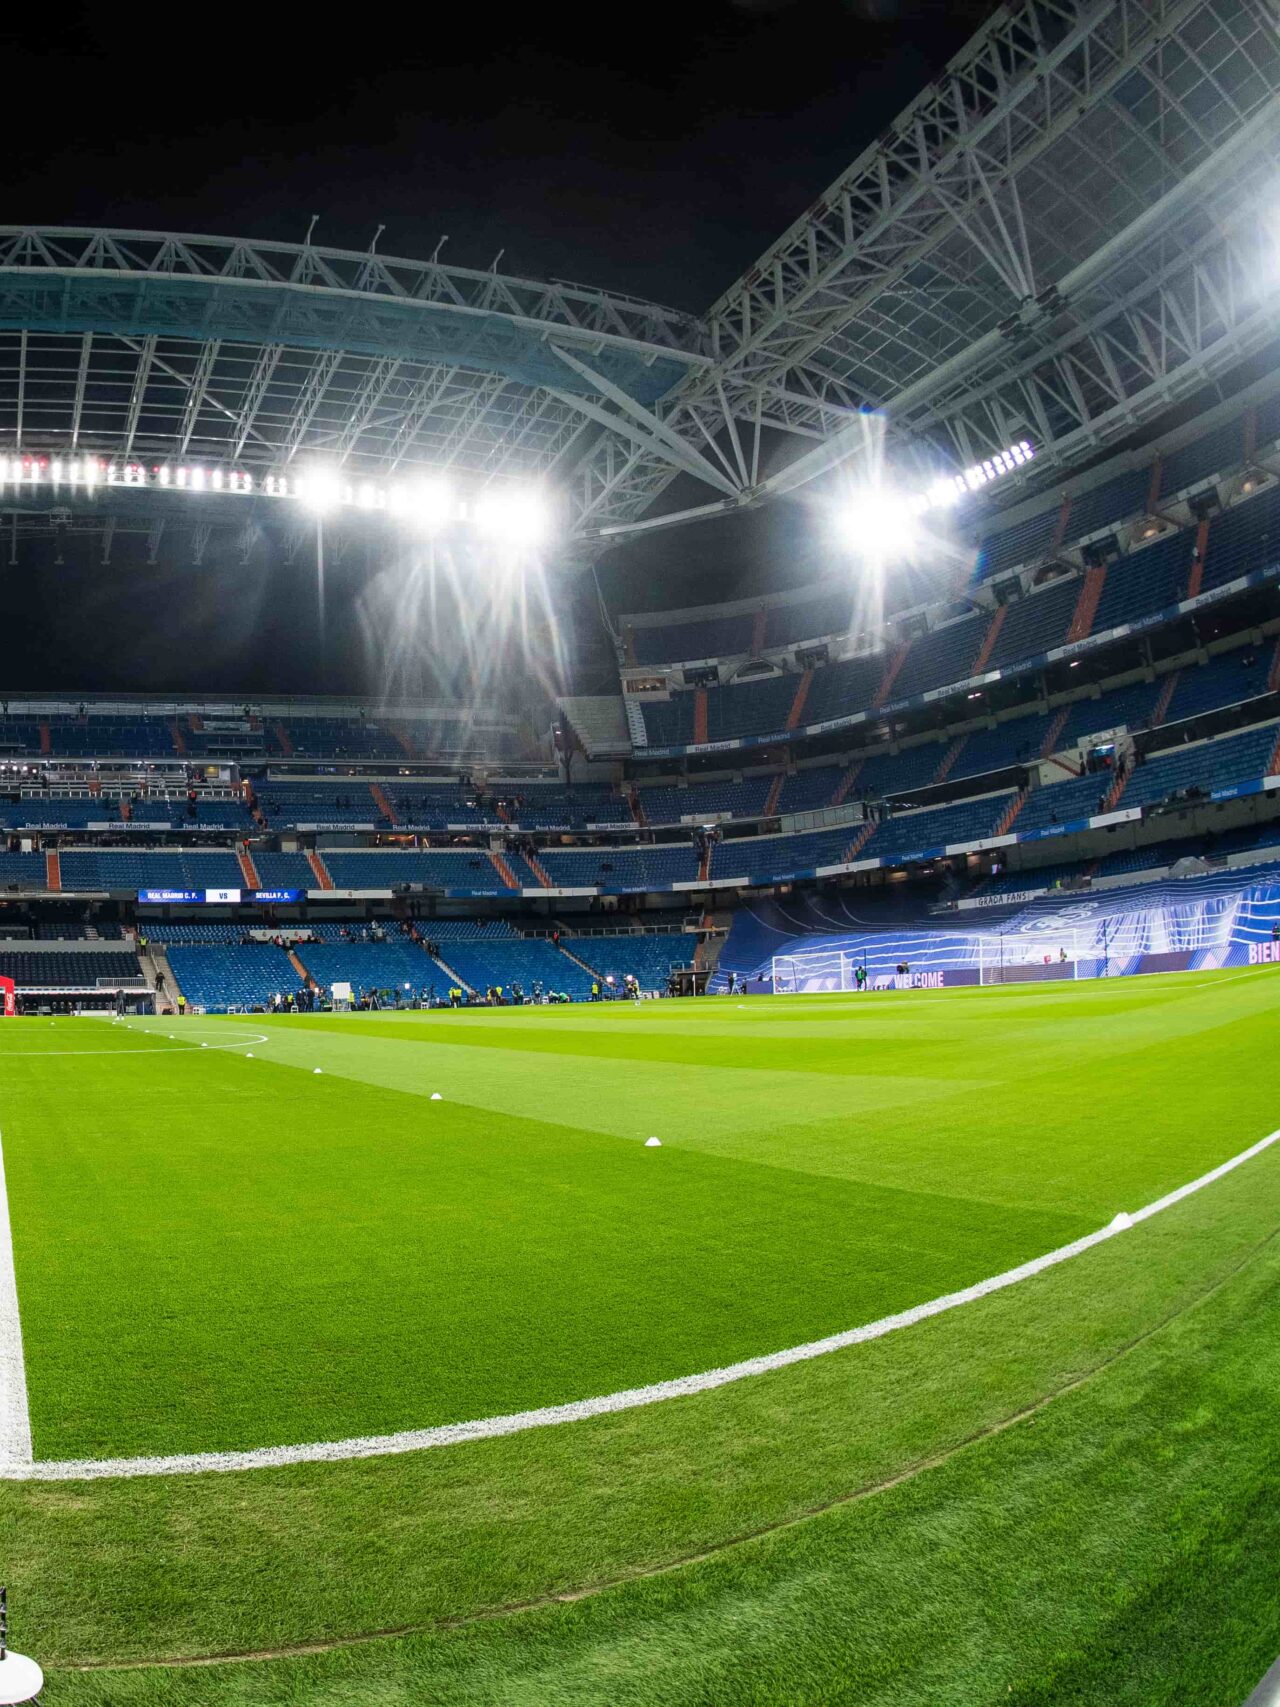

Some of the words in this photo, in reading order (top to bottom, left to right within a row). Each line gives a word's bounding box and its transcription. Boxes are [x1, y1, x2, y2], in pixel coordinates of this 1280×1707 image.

[710, 743, 731, 751] Madrid
[978, 897, 1004, 906] GRADA
[1006, 892, 1027, 902] FANS
[894, 971, 944, 989] WELCOME
